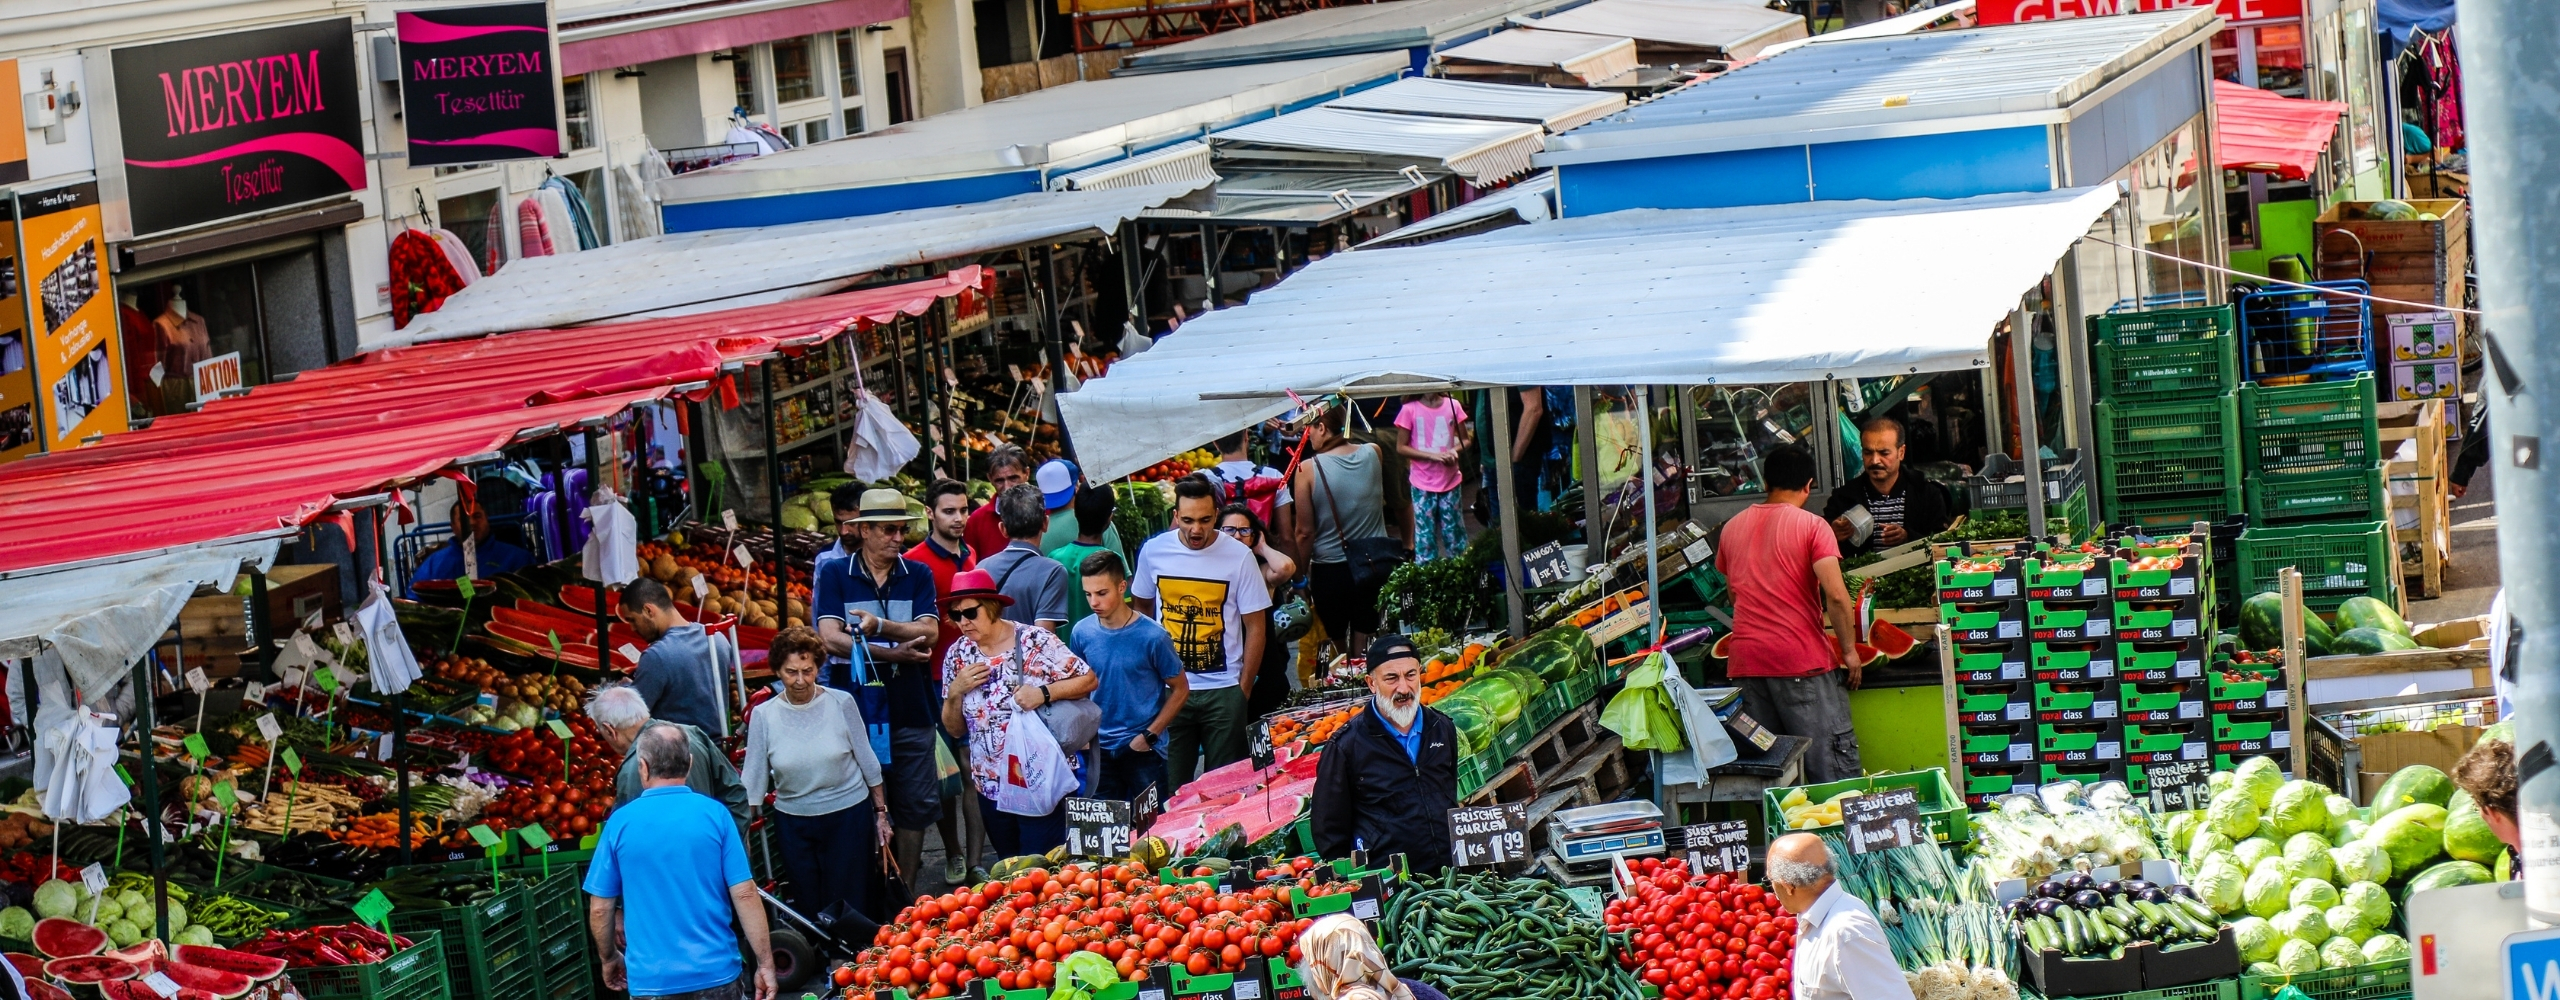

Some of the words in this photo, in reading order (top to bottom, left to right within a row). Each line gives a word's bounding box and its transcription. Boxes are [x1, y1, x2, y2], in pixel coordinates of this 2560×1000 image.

[413, 51, 542, 82] MERYEM
[159, 50, 325, 138] MERYEM
[199, 357, 240, 396] AKTION
[1943, 589, 1962, 599] royal
[1964, 587, 1983, 598] class
[2031, 589, 2051, 598] royal
[2053, 587, 2072, 597] class
[2118, 589, 2138, 598] royal
[2141, 586, 2159, 597] class
[1205, 607, 1218, 617] NYC
[1952, 631, 1968, 640] oyal
[1970, 629, 1988, 640] class
[2035, 630, 2054, 639] royal
[2057, 628, 2075, 638] class
[2121, 630, 2140, 640] royal
[2143, 628, 2162, 639] class
[1955, 673, 1971, 681] oyal
[1973, 670, 1991, 681] class
[2038, 671, 2058, 680] royal
[2060, 669, 2079, 679] class
[2125, 671, 2144, 681] royal
[2147, 669, 2166, 680] class
[2289, 684, 2297, 711] KAR700
[2215, 701, 2234, 711] royal
[2237, 699, 2256, 710] class
[1959, 714, 1976, 722] oyal
[1977, 711, 1996, 722] class
[2042, 711, 2061, 721] royal
[2064, 709, 2082, 720] class
[2128, 712, 2148, 721] royal
[2150, 710, 2169, 721] class
[2219, 742, 2239, 751] royal
[2241, 740, 2260, 751] class
[1962, 755, 1978, 763] oyal
[1980, 752, 1998, 763] class
[2045, 752, 2064, 761] royal
[2067, 750, 2086, 761] class
[2132, 754, 2151, 763] royal
[2154, 751, 2172, 762] class
[2151, 774, 2189, 788] KRAUT
[1858, 791, 1916, 811] ZWIEBEL
[1966, 796, 1981, 804] oyal
[1983, 793, 1999, 804] clas
[1068, 800, 1107, 811] RISPEN
[1068, 811, 1114, 823] TOMATEN
[1452, 808, 1503, 823] FRISCHE
[1455, 818, 1507, 836] GURKEN
[1085, 835, 1099, 848] KG
[1687, 836, 1713, 848] EIER
[545, 843, 559, 853] lass
[1468, 844, 1485, 857] KG
[448, 852, 465, 860] class
[1703, 855, 1721, 867] KG
[1280, 987, 1302, 1000] royal
